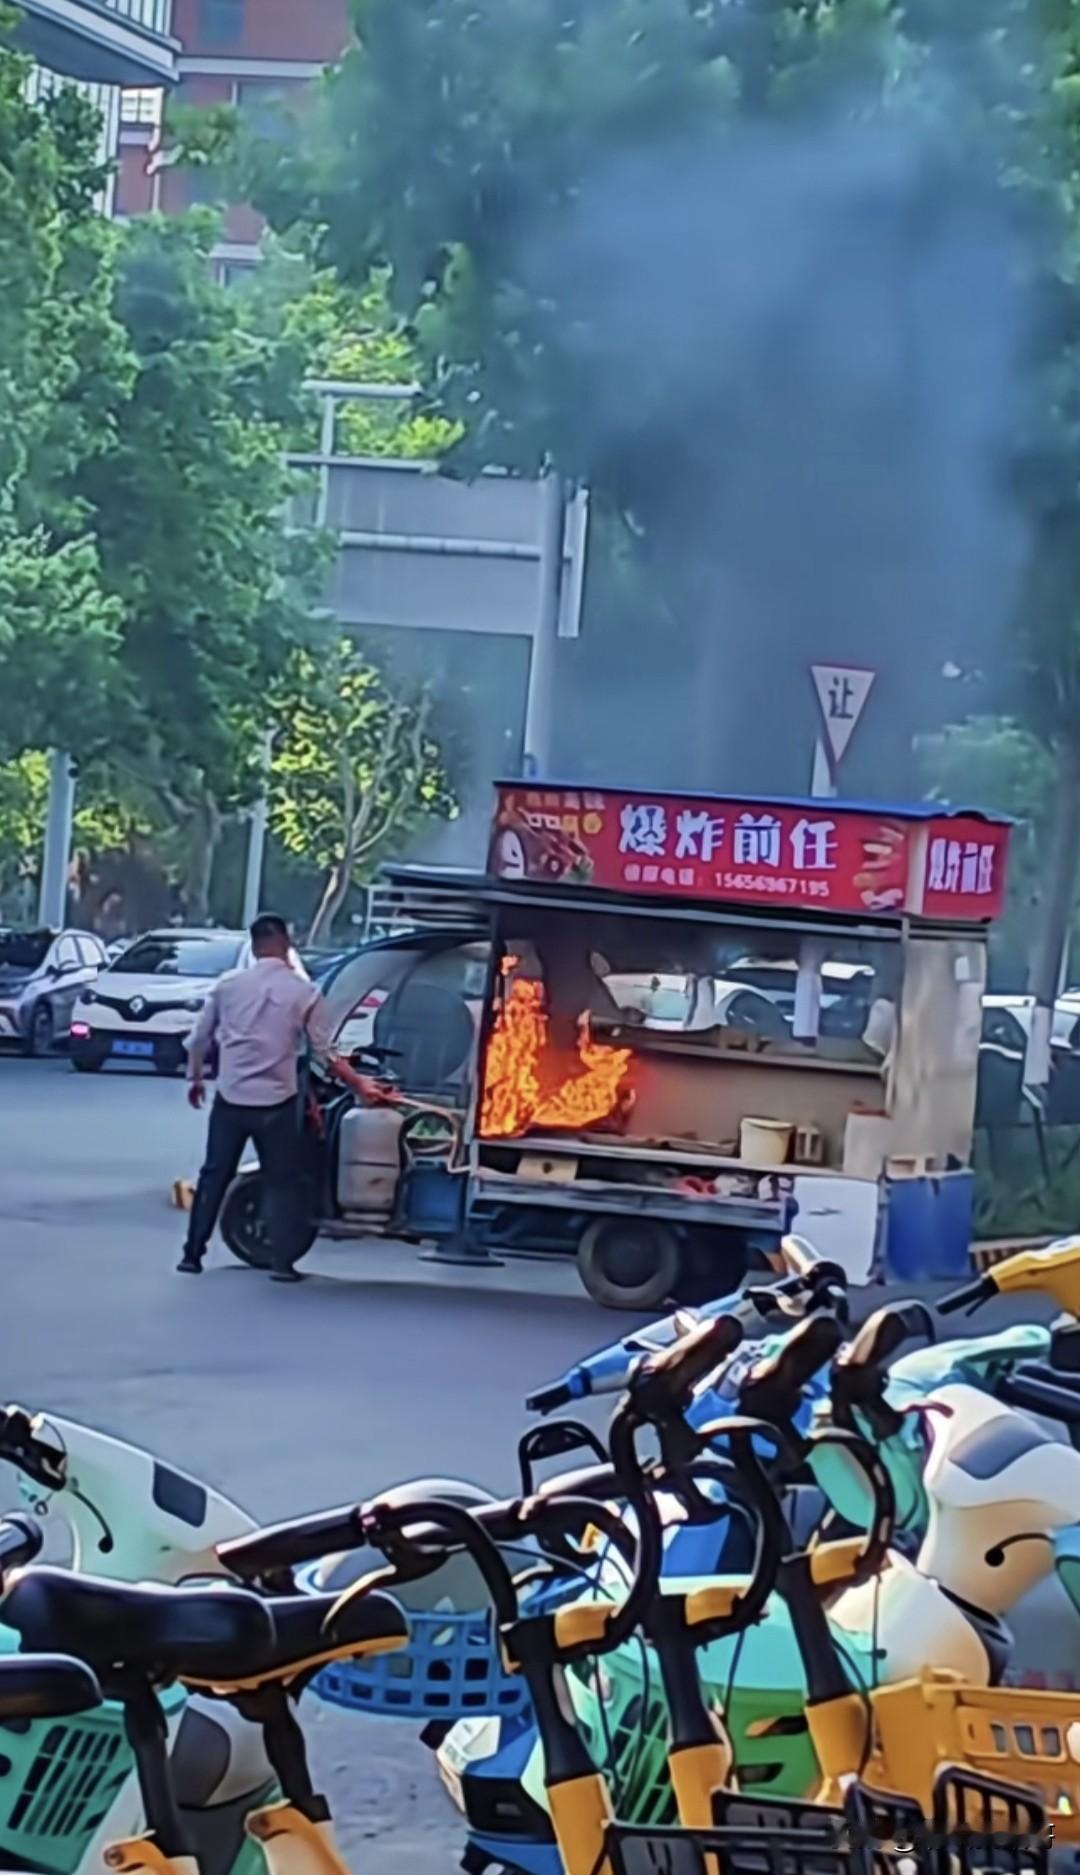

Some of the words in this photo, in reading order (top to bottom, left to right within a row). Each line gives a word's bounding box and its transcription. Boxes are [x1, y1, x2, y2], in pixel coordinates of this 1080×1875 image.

[827, 676, 854, 719] 让
[618, 804, 838, 870] 爆炸前任
